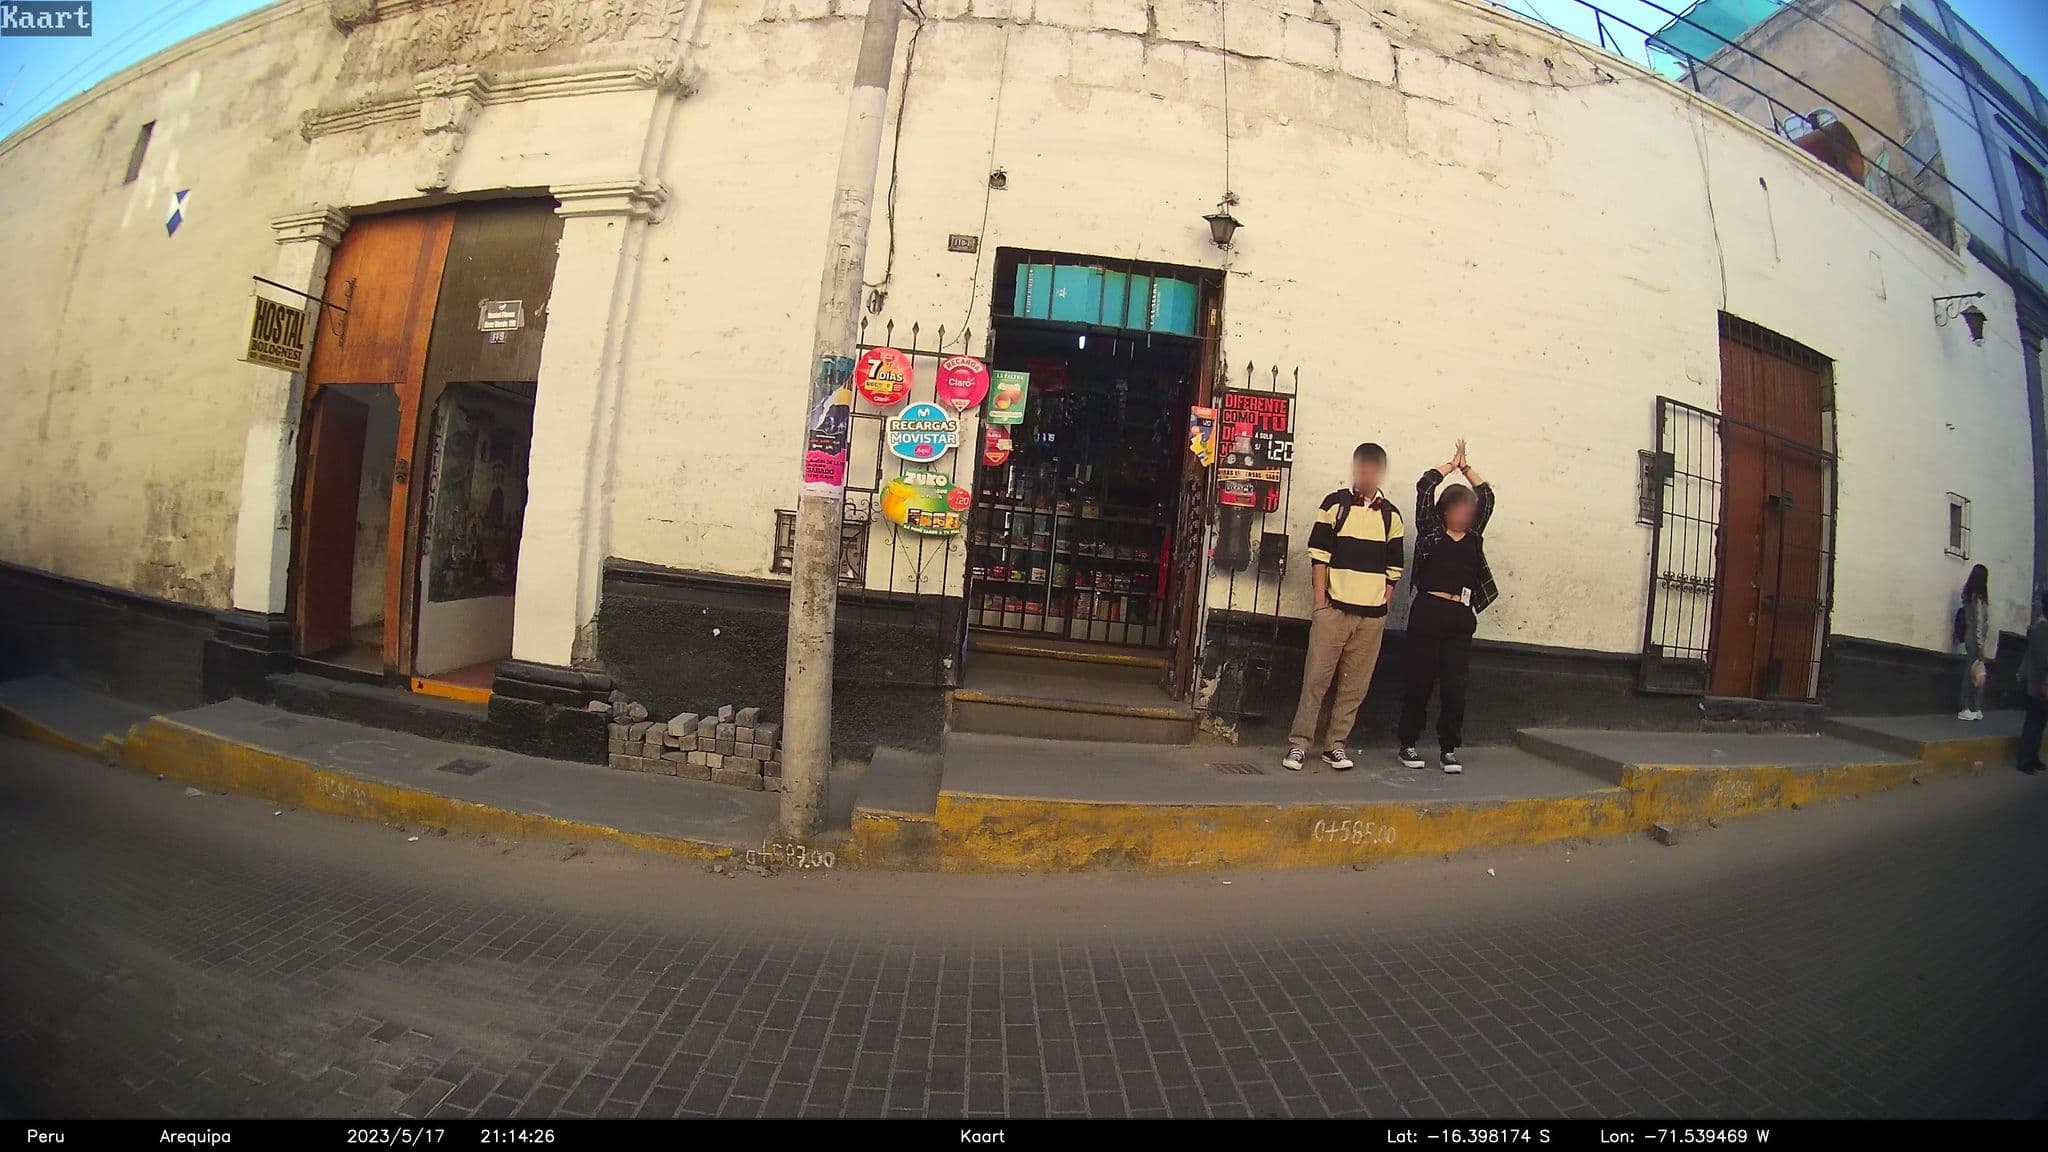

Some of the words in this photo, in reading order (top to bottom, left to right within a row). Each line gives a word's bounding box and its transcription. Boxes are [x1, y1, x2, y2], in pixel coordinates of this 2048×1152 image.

[252, 300, 305, 350] HOSTAL
[867, 359, 882, 378] 7
[945, 356, 981, 372] RECARGA
[948, 377, 976, 388] Claro
[1225, 393, 1287, 414] DIFERENTE
[1223, 410, 1257, 424] COMO
[892, 420, 957, 432] RECARGAS
[891, 432, 956, 445] MOVISTAR
[1267, 440, 1294, 462] 1.20
[903, 471, 948, 487] ZUKO
